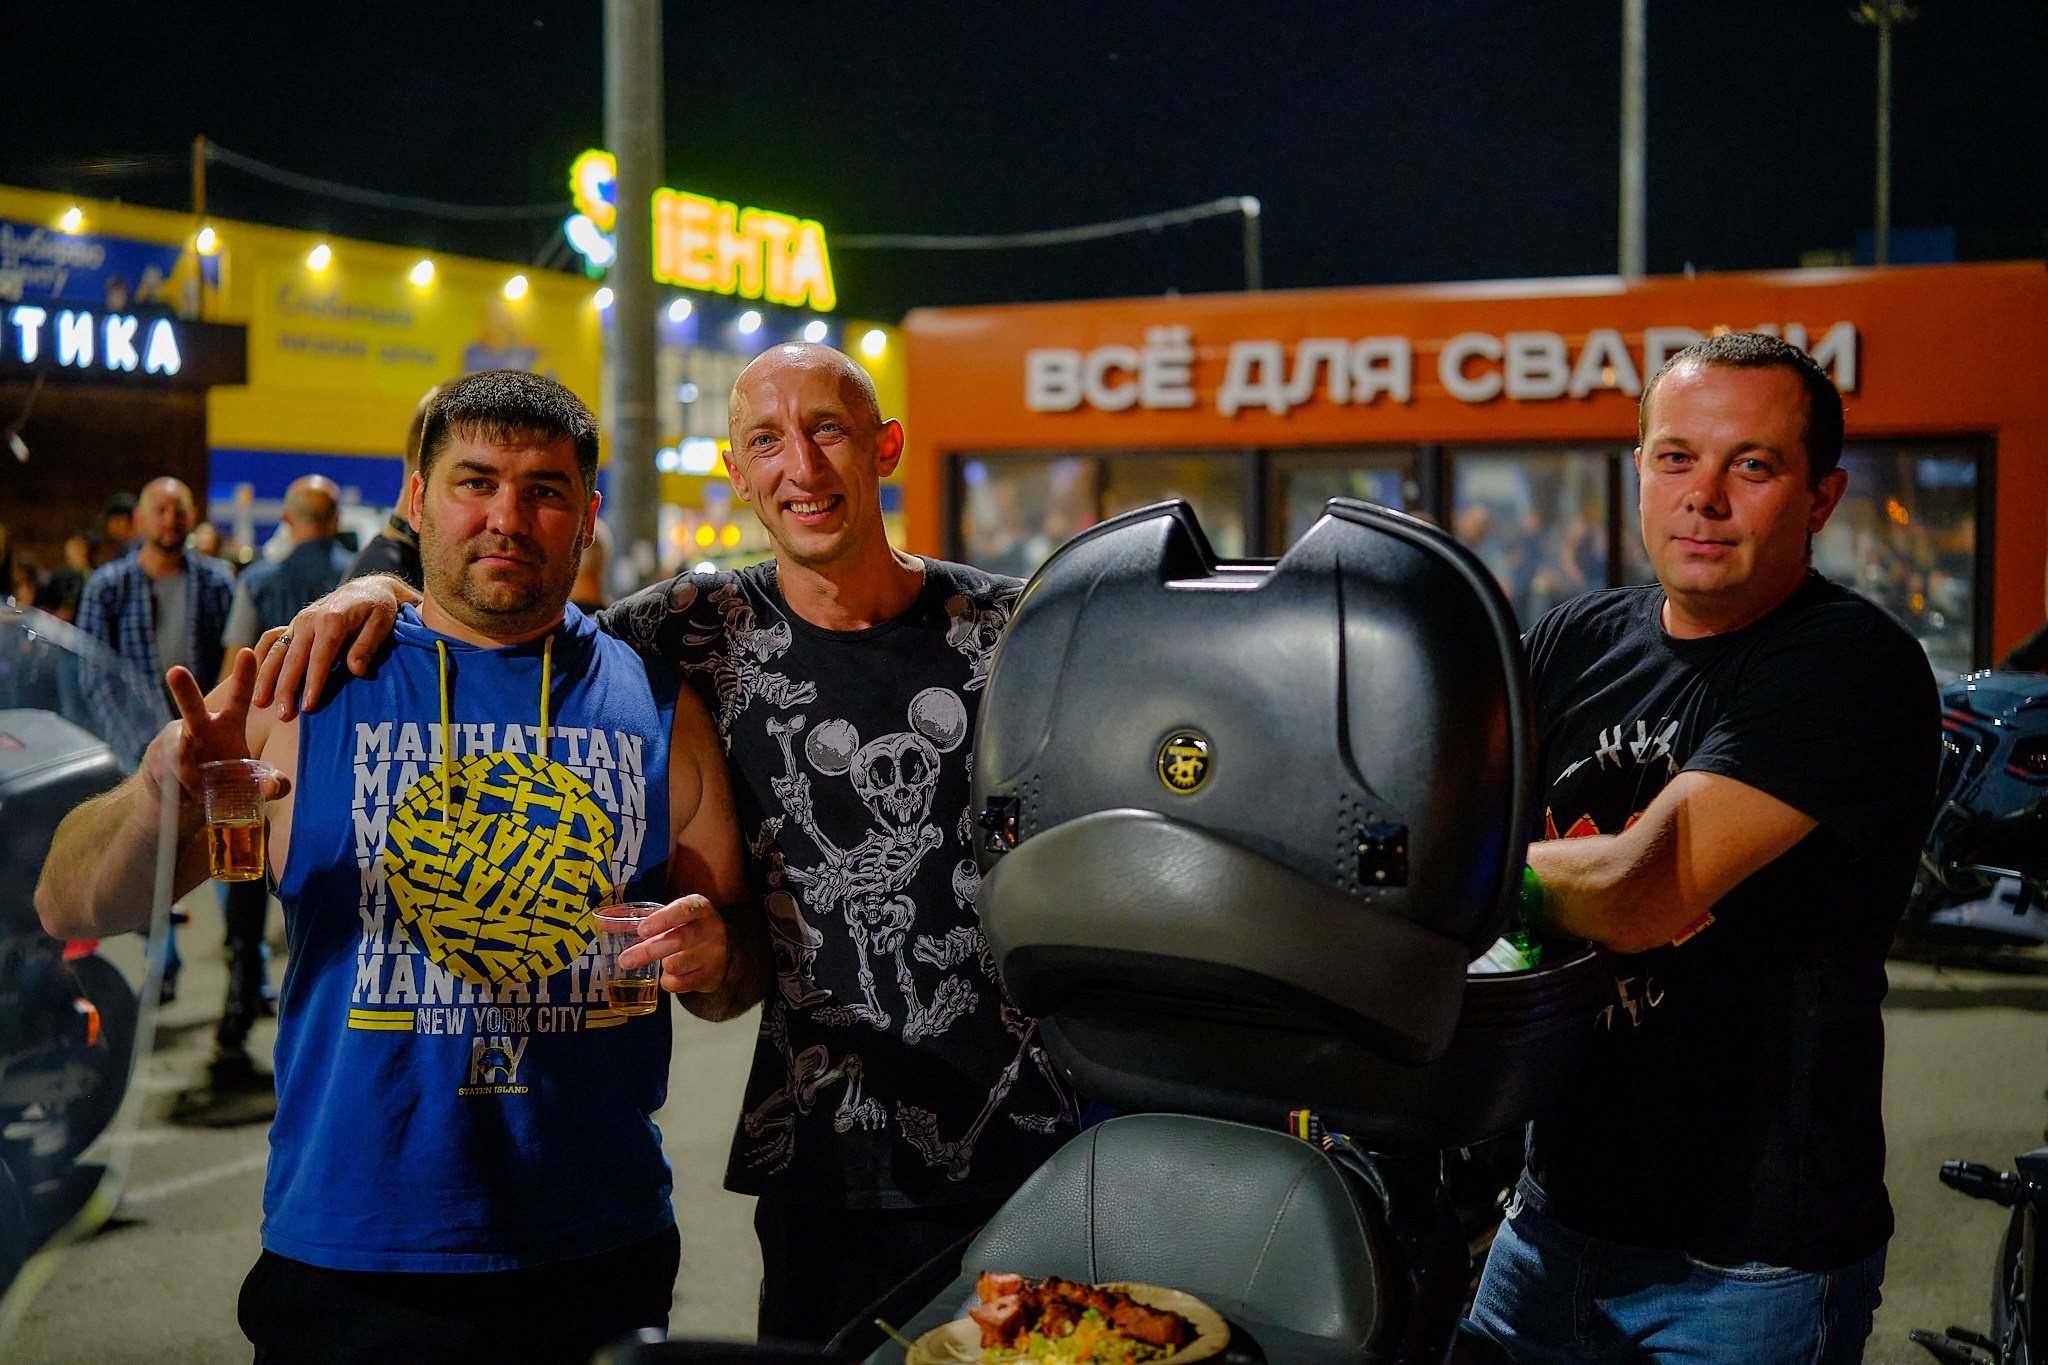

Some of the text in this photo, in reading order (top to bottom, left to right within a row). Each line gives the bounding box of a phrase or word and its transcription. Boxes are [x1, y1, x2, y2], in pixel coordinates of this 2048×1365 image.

[0, 305, 181, 376] ТИКА
[1025, 321, 1857, 416] ВСЁ ДЛЯ СВАРИ
[354, 722, 643, 776] MANHATTAN
[416, 1006, 583, 1035] NEW YORK CITY
[458, 1085, 529, 1096] STATEN ISLAND
